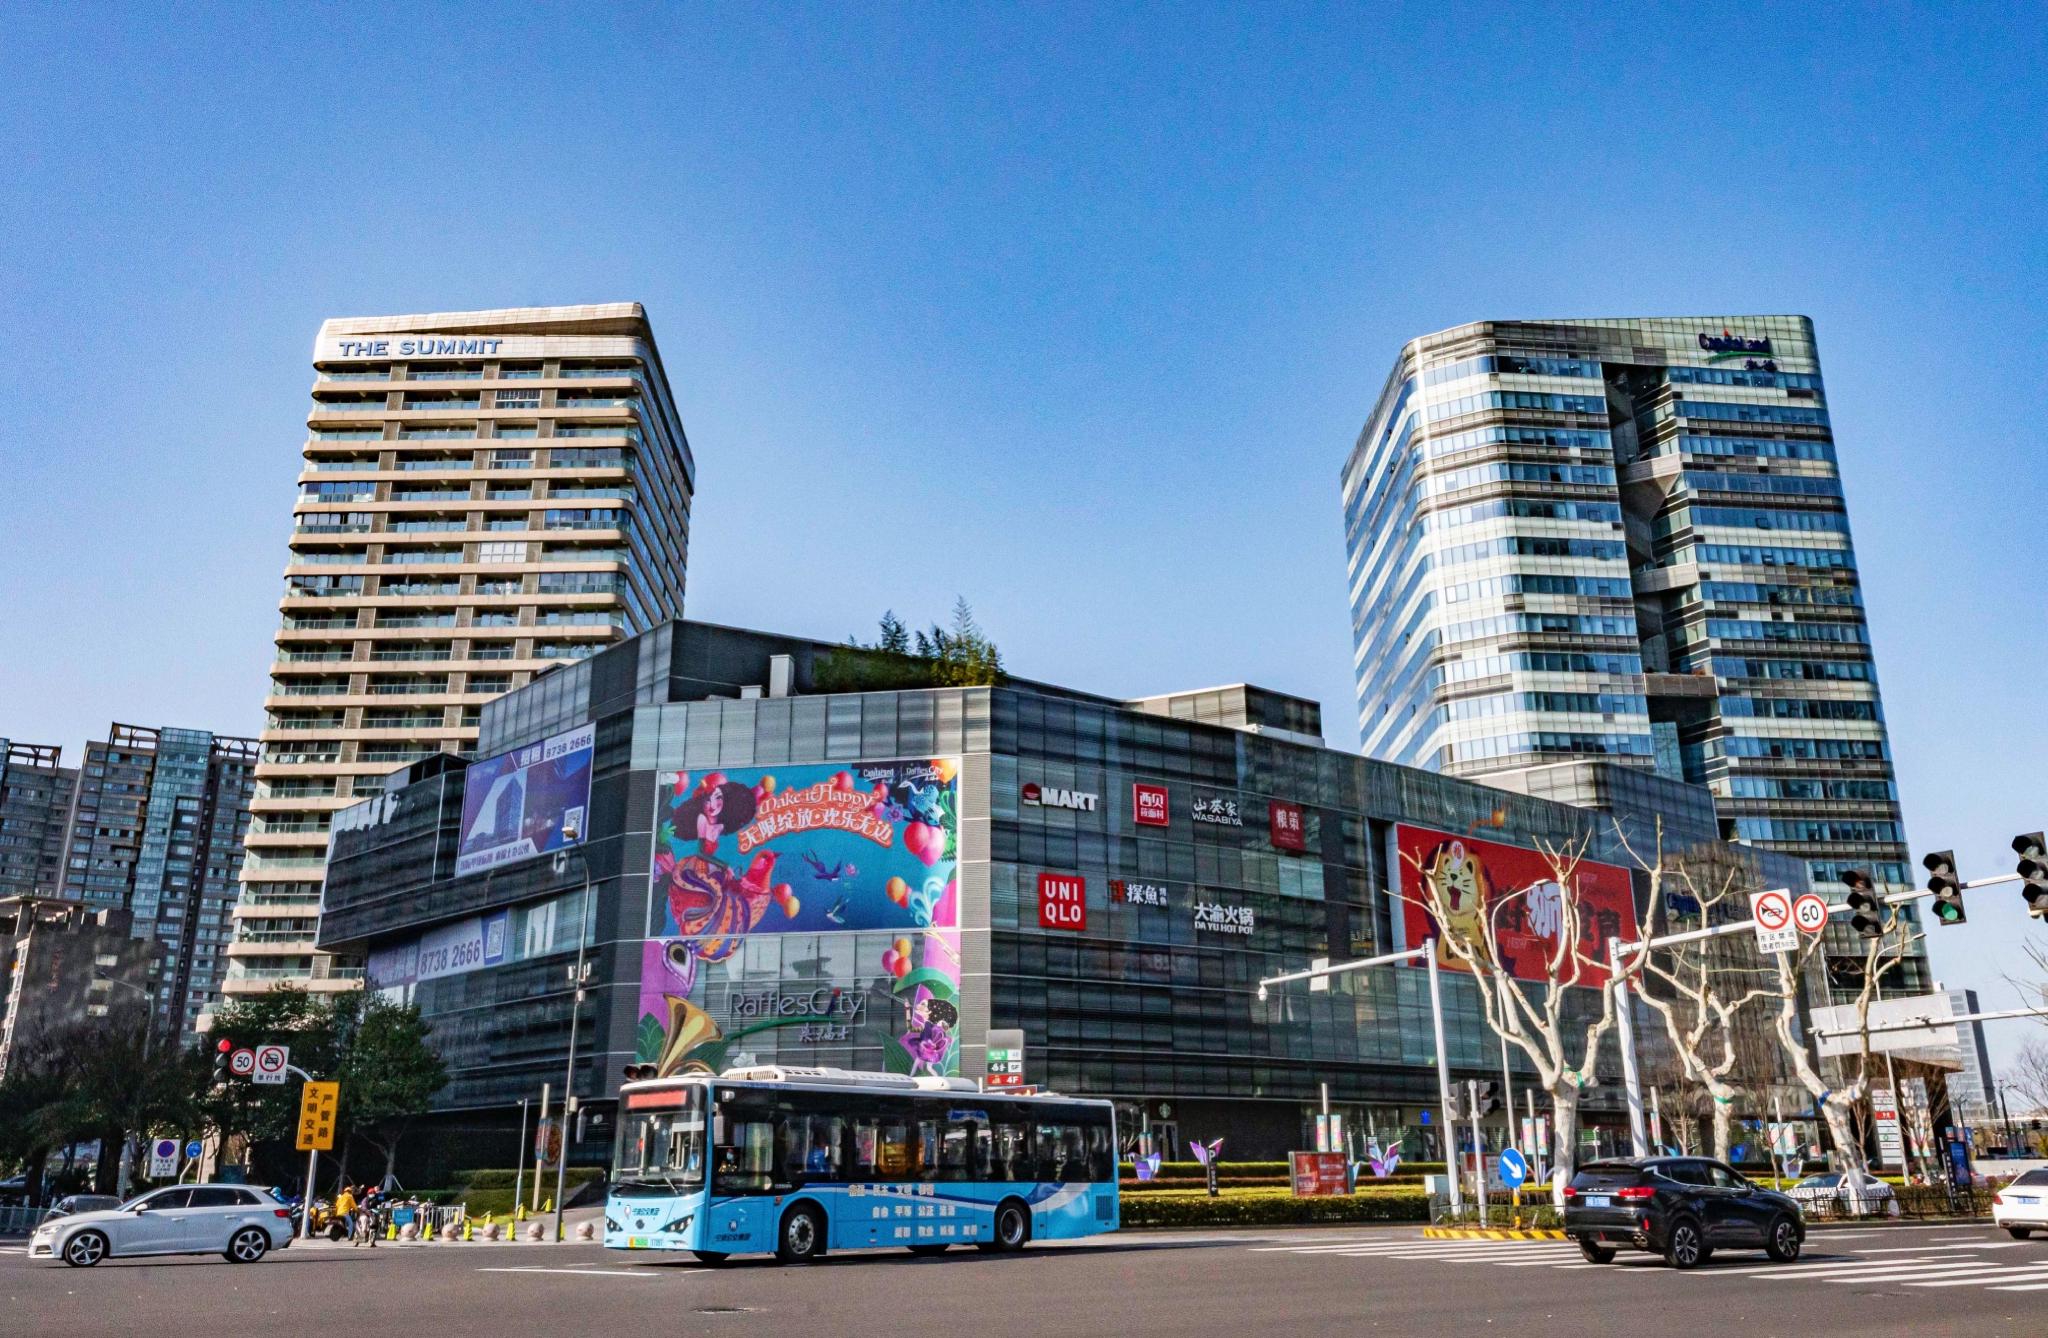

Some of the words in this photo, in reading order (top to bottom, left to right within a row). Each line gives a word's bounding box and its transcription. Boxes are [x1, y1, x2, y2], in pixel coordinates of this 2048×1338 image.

[339, 341, 389, 356] THE
[399, 338, 503, 355] SUMMIT
[570, 735, 592, 750] 2666
[759, 794, 799, 814] Make
[805, 790, 815, 803] it
[813, 778, 880, 812] Happy
[1041, 787, 1098, 811] MART
[1139, 791, 1164, 809] 西贝
[1192, 812, 1243, 827] WASABIYA
[1045, 880, 1078, 901] UNI
[1045, 902, 1081, 924] QLO
[1194, 902, 1253, 925] 大渝火锅
[1801, 905, 1819, 922] 60
[1194, 921, 1206, 930] DA
[1208, 922, 1219, 931] YU
[1221, 923, 1237, 933] HOT
[1238, 924, 1253, 935] POT
[421, 948, 448, 975] 8738
[451, 939, 480, 968] 2666
[729, 987, 863, 1020] RafflesCity
[236, 1056, 249, 1068] 50
[1007, 1075, 1019, 1084] 4F
[304, 1088, 318, 1144] 文明交通
